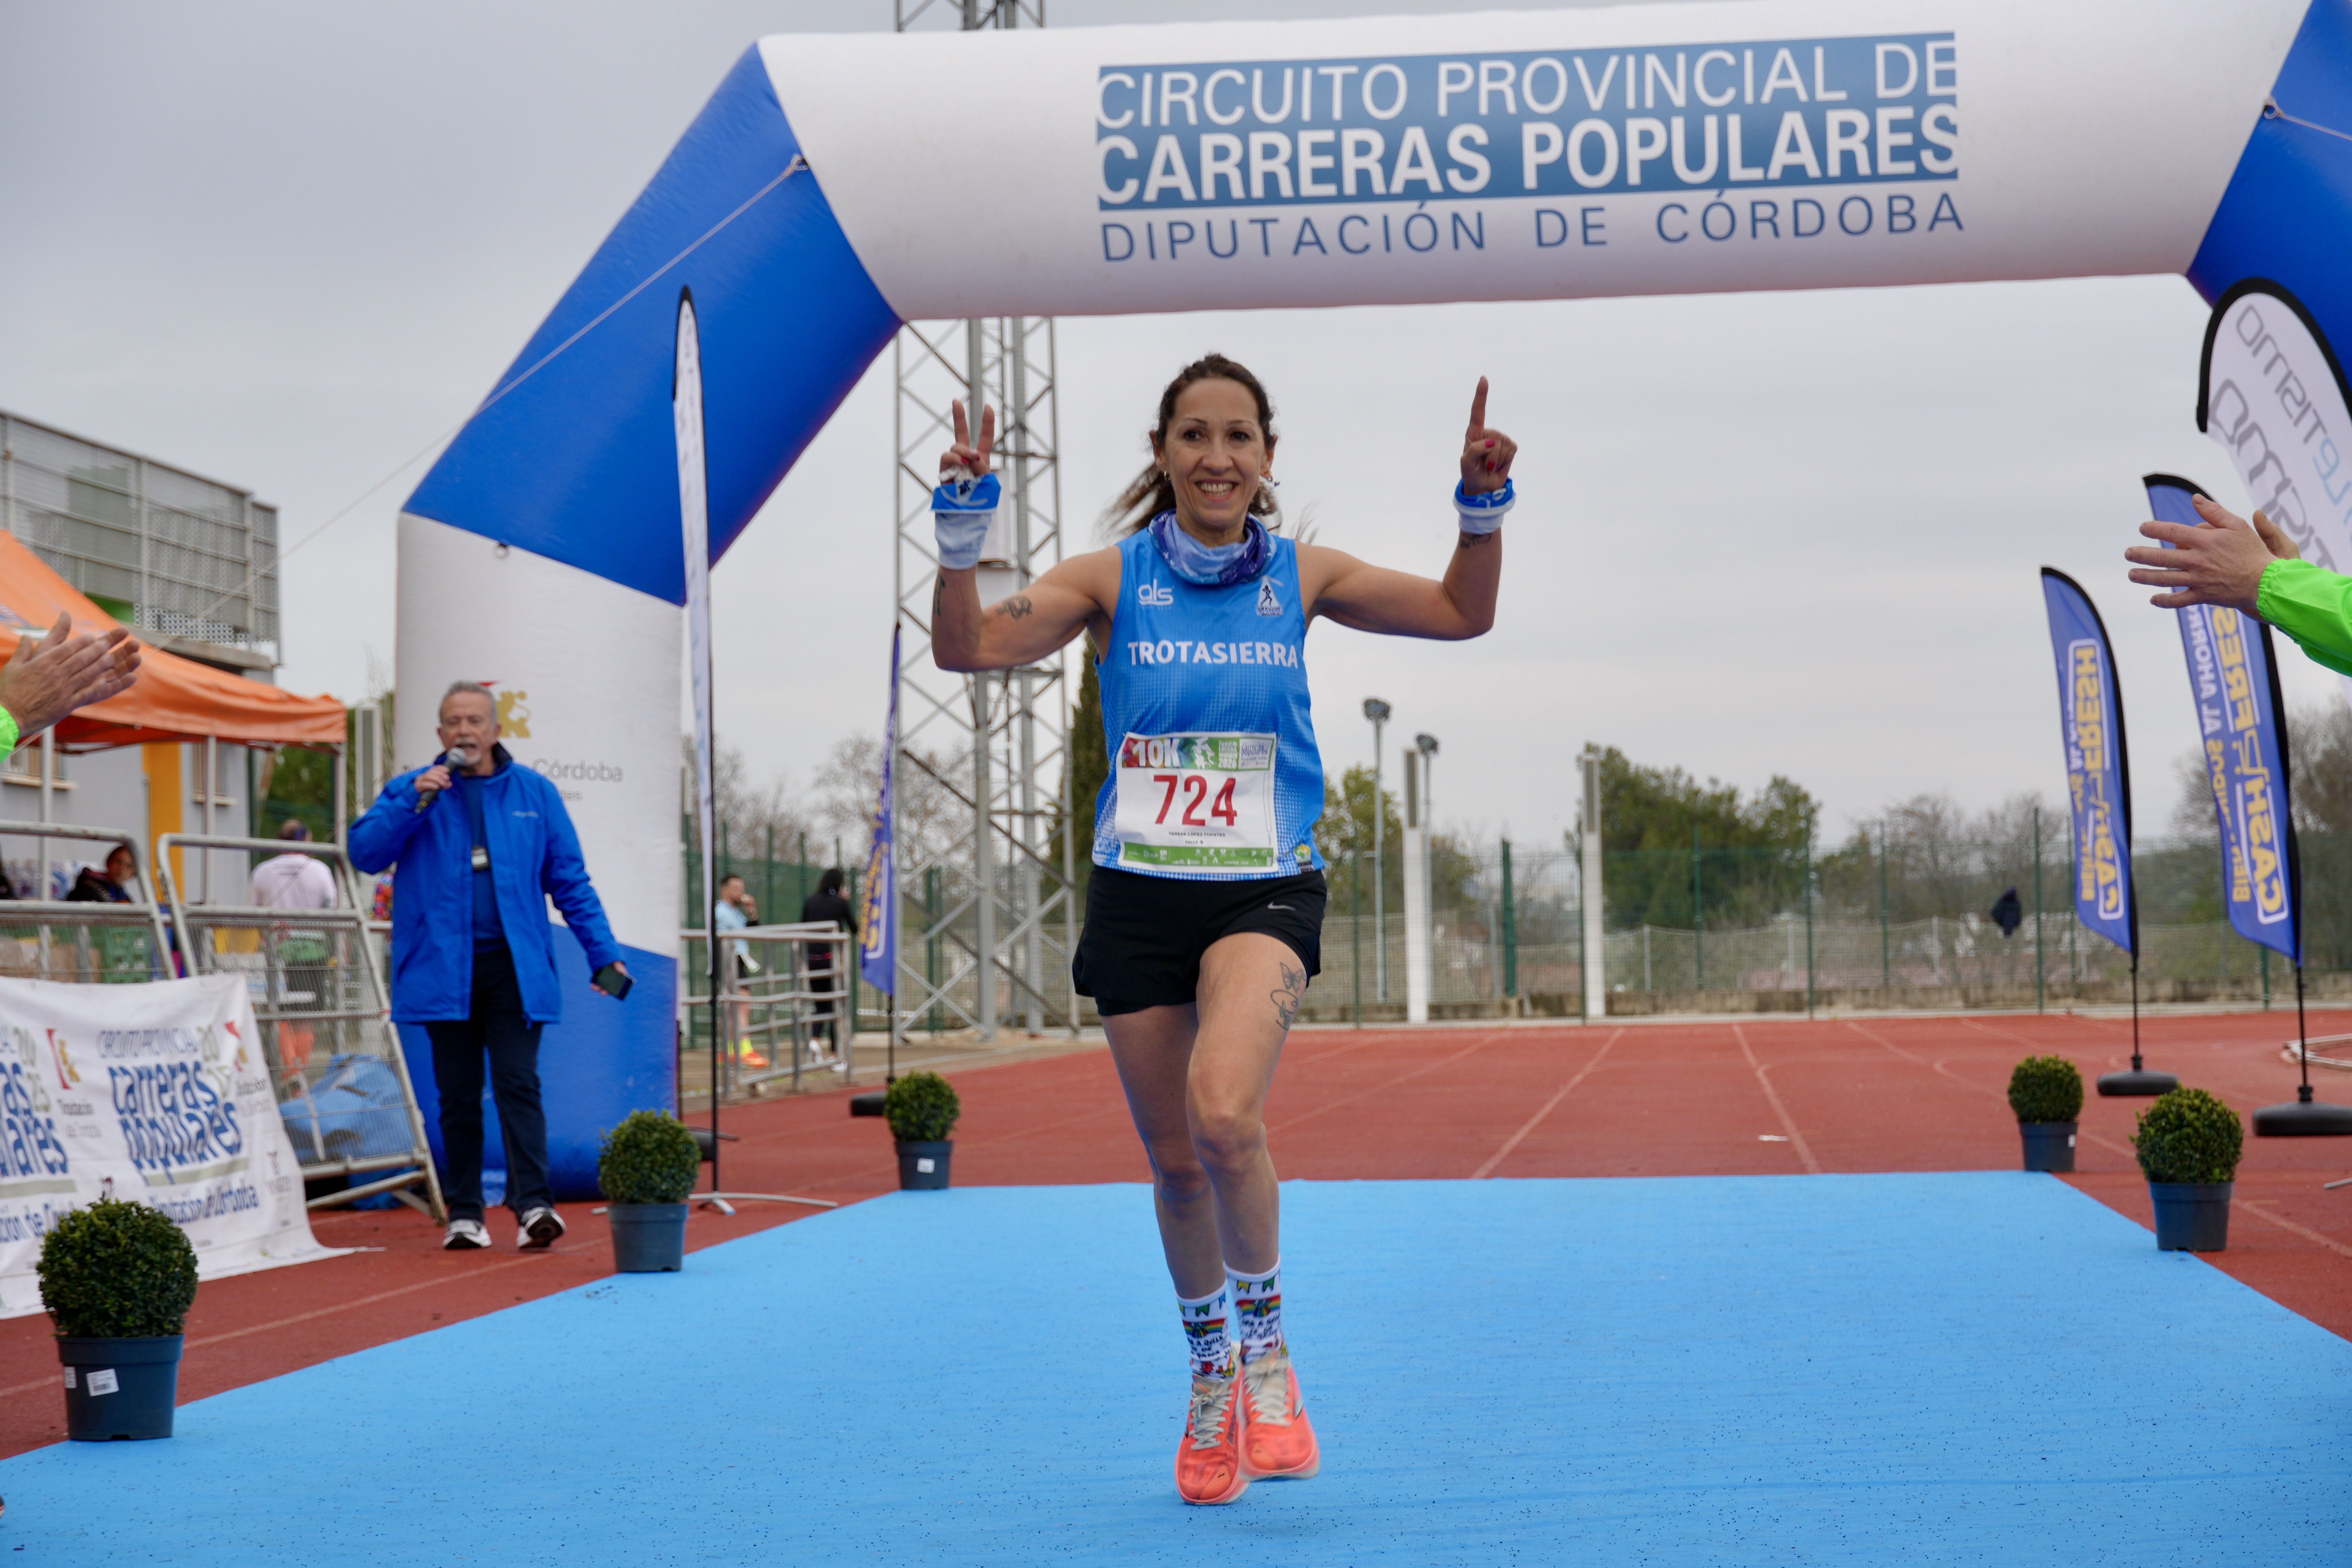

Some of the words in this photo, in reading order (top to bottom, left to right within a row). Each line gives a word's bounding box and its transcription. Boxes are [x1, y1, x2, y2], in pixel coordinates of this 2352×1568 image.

[1097, 63, 1408, 129] CIRCUITO
[1437, 46, 1848, 117] PROVINCIAL
[1875, 40, 1956, 99] DE
[1097, 122, 1492, 204] CARRERAS
[1522, 103, 1958, 190] POPULARES
[1101, 201, 1485, 262] DIPUTACIÓN
[1535, 206, 1608, 248] DE
[1656, 189, 1964, 243] CÓRDOBA
[1127, 639, 1298, 669] TROTASIERRA
[532, 758, 623, 783] Córdoba
[1132, 738, 1181, 768] 10K
[1153, 775, 1238, 827] 724
[108, 1061, 218, 1116] carreras
[119, 1102, 243, 1187] populares
